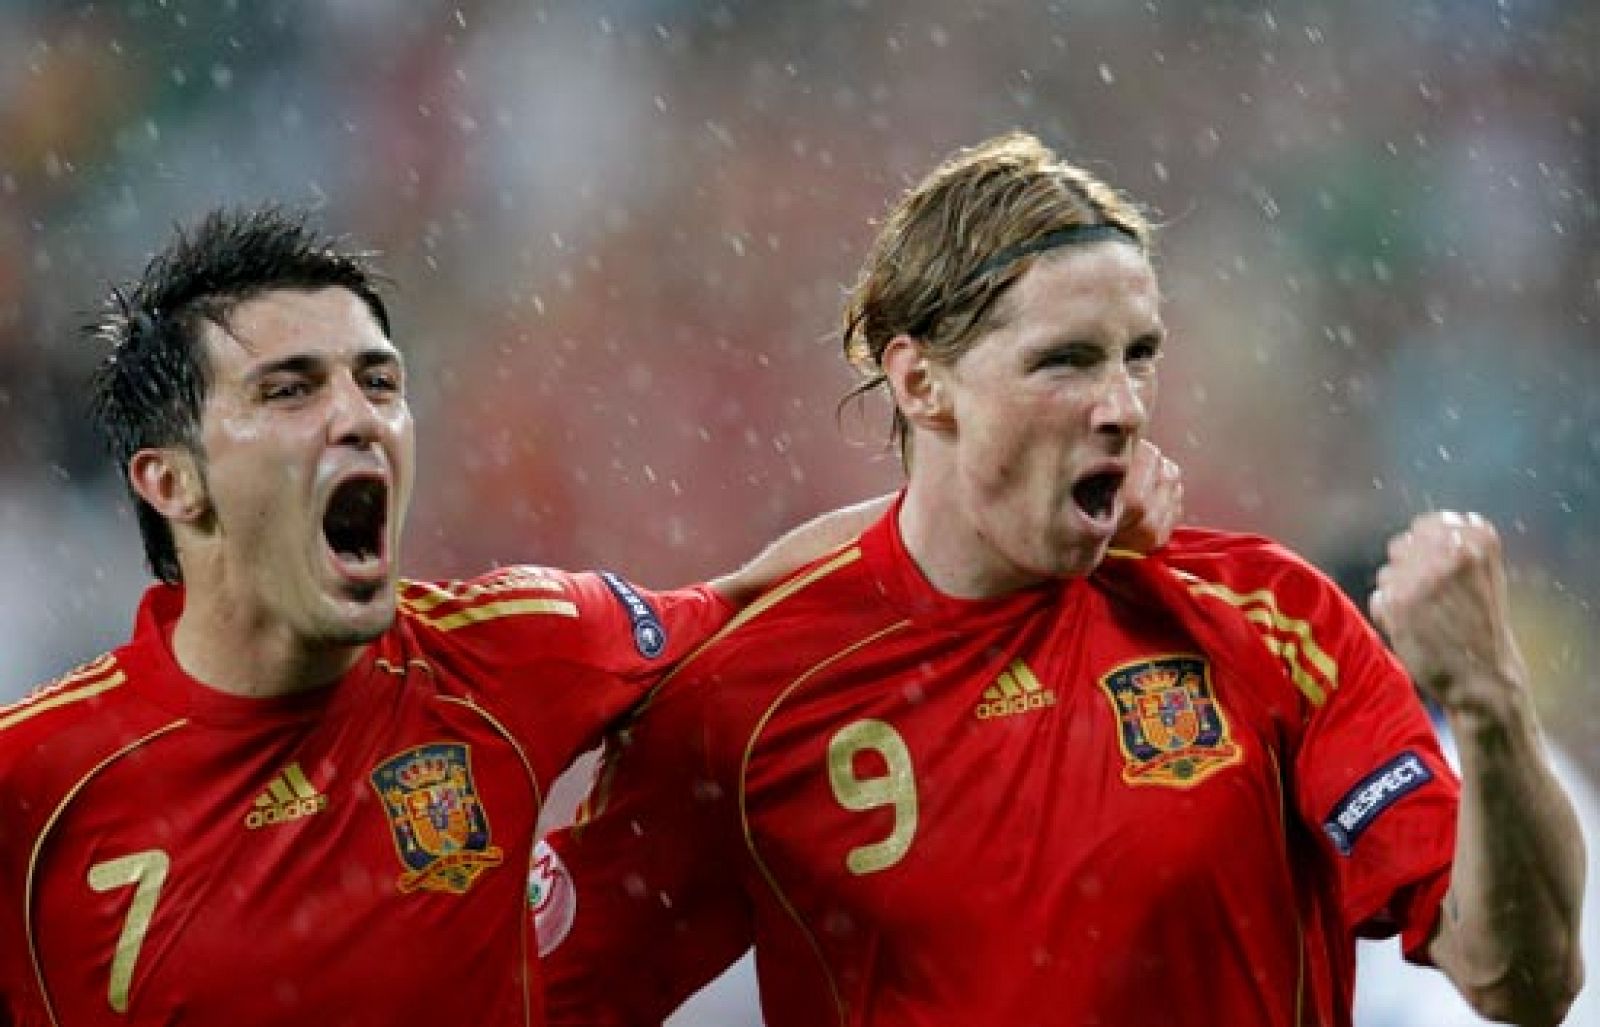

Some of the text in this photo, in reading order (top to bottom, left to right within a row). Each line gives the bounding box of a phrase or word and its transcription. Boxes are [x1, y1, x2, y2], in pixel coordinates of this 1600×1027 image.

[975, 689, 1056, 719] adidas
[827, 719, 919, 876] 9
[1337, 758, 1424, 829] RESPECT
[87, 849, 170, 1013] 7
